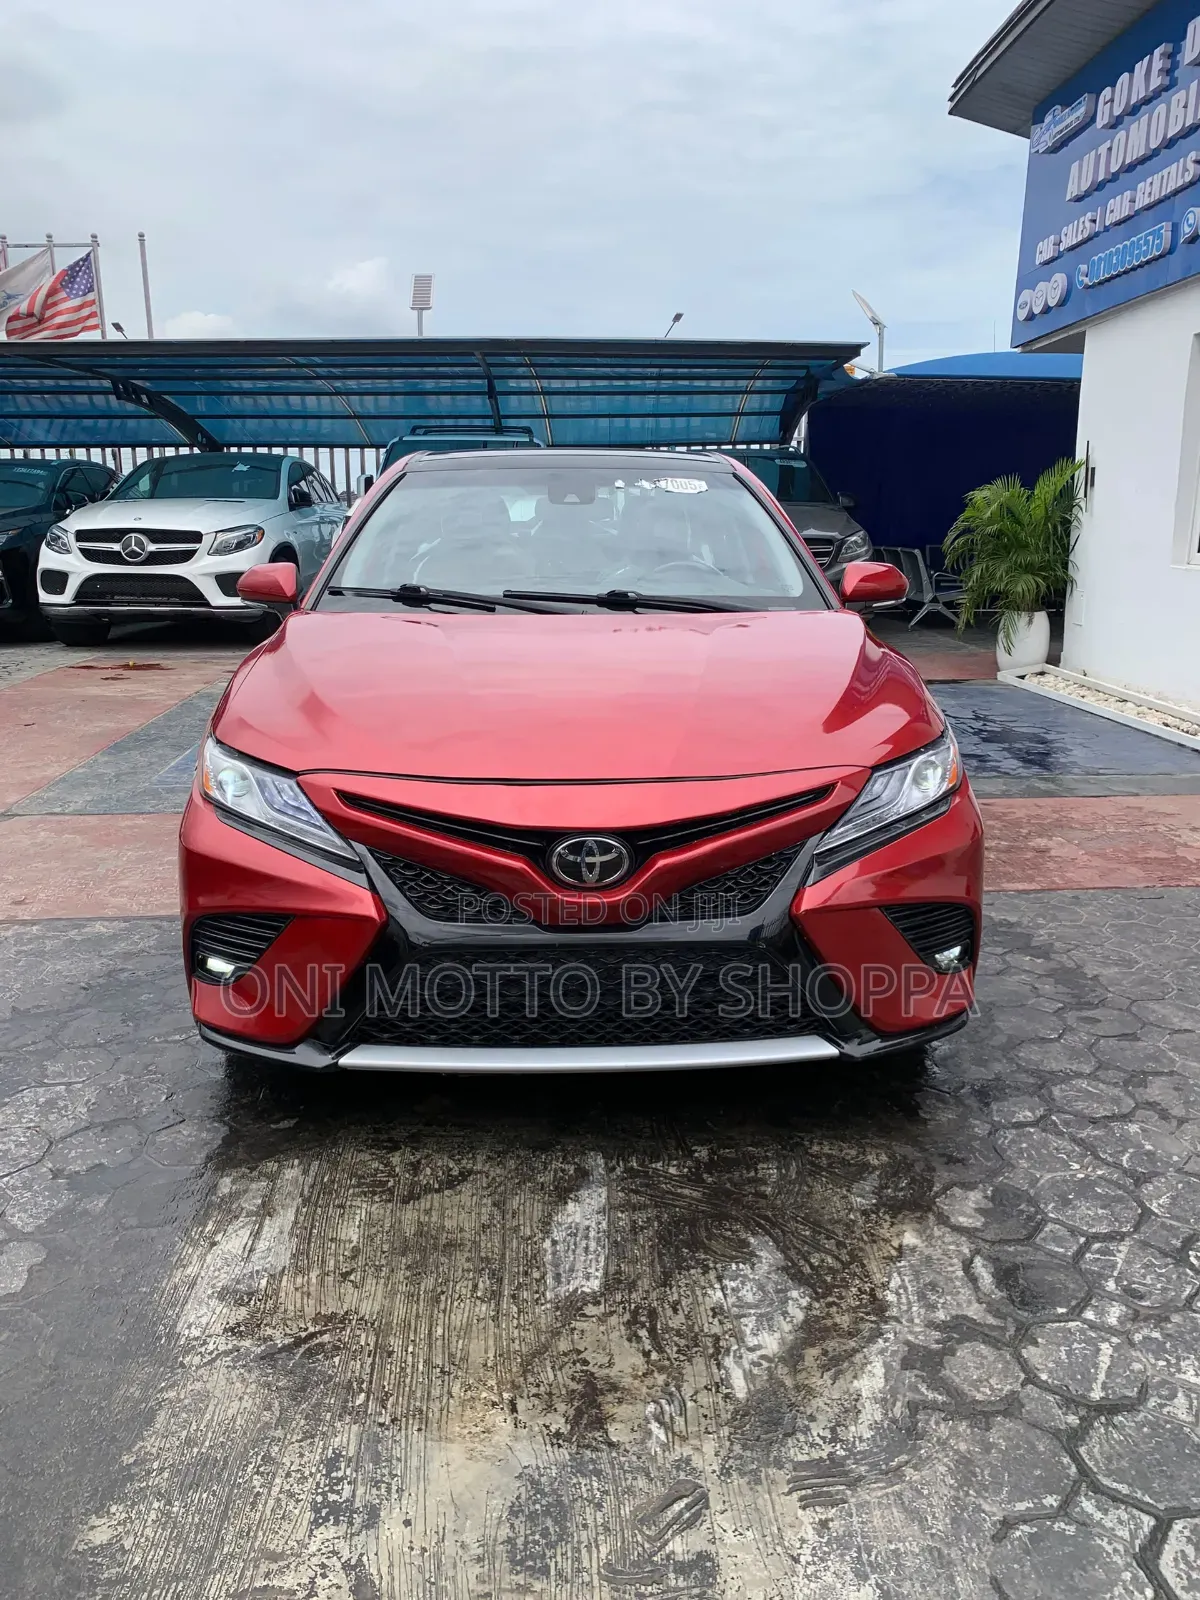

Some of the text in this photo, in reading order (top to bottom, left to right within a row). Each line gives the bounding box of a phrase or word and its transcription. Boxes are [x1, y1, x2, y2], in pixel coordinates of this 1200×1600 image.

[1066, 79, 1200, 201] AUTOMOBI
[1096, 42, 1168, 129] GOKE
[1035, 234, 1057, 266] CAR
[1059, 212, 1093, 251] SALES
[1105, 190, 1132, 226] CAR
[1134, 151, 1197, 212] RENTALS
